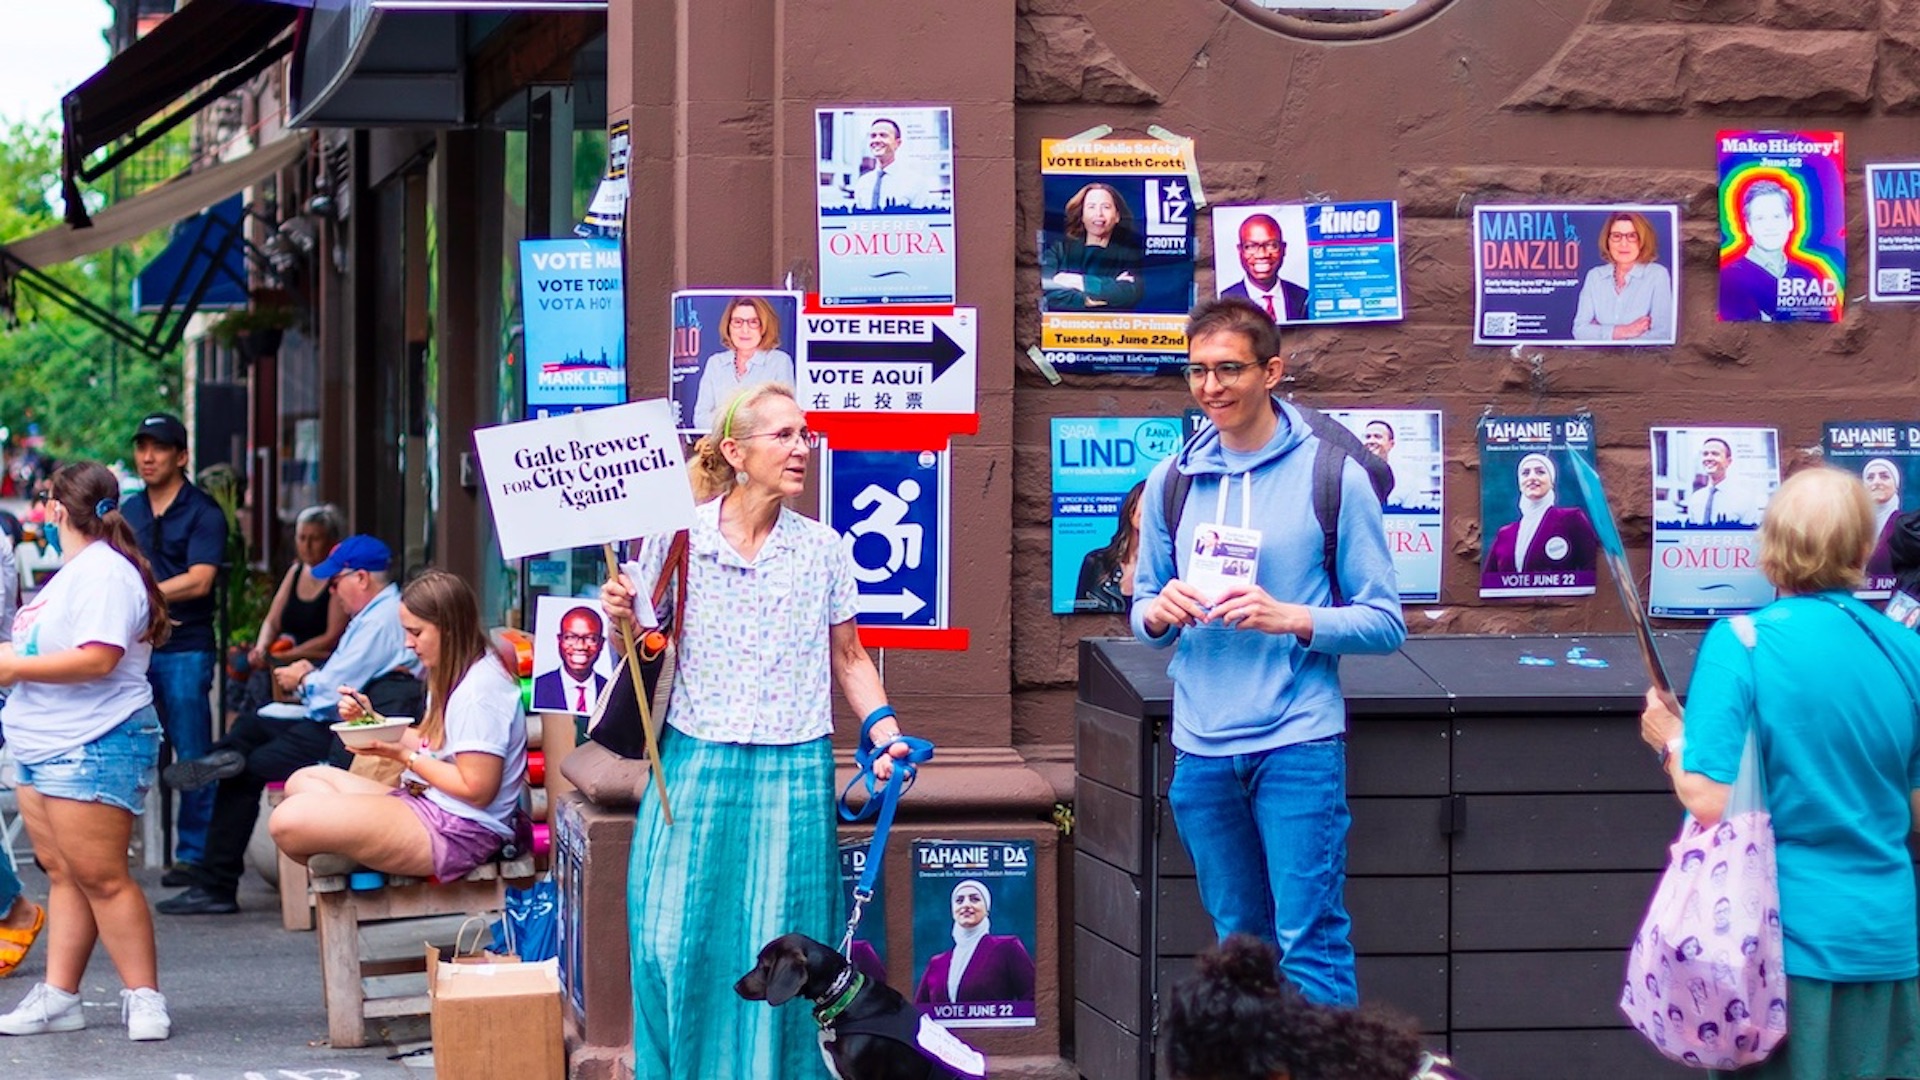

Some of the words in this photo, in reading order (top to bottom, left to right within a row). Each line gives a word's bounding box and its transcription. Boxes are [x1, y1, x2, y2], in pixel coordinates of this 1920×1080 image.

[1722, 138, 1768, 153] Make
[1769, 138, 1840, 156] History!
[1047, 157, 1082, 167] VOTE
[1085, 157, 1142, 167] Elizabeth
[1760, 157, 1787, 167] June
[1788, 157, 1802, 167] 22
[850, 220, 927, 232] JEFFREY
[1320, 209, 1381, 234] KINGO
[1482, 212, 1557, 240] MARIA
[829, 232, 946, 256] OMURA
[1146, 237, 1187, 249] CROTTY
[532, 252, 592, 270] VOTE
[1484, 241, 1579, 270] DANZILO
[538, 279, 583, 292] VOTE
[1777, 278, 1837, 296] BRAD
[538, 298, 585, 311] VOTA
[590, 297, 612, 310] HOY
[1777, 296, 1837, 307] HOYLMAN
[807, 319, 861, 334] VOTE
[868, 319, 925, 335] HERE
[1050, 317, 1131, 330] Democratic
[1133, 318, 1188, 332] Primary
[1116, 334, 1149, 345] June
[1151, 334, 1185, 346] 22nd
[538, 371, 585, 385] MARK
[808, 369, 864, 385] VOTE
[872, 366, 924, 385] AQUÍ
[812, 391, 924, 410] 在此投票
[1059, 423, 1097, 439] SARA
[1485, 422, 1552, 438] TAHANIE
[1565, 422, 1588, 437] DA
[1829, 427, 1897, 443] TAHANIE
[514, 444, 567, 470] Gale
[568, 432, 650, 462] Brewer
[1059, 439, 1136, 468] LIND
[502, 479, 533, 495] FOR
[532, 466, 576, 490] City
[578, 447, 675, 482] Council.
[559, 478, 628, 511] Again!
[1059, 504, 1082, 514] JUNE
[1097, 504, 1118, 514] 2021
[1501, 574, 1530, 586] VOTE
[1532, 574, 1560, 586] JUNE
[1561, 573, 1576, 585] 22
[918, 847, 989, 864] TAHANIE
[1002, 847, 1027, 863] DA
[934, 1005, 965, 1018] VOTE
[967, 1004, 996, 1017] JUNE
[999, 1004, 1014, 1016] 22
